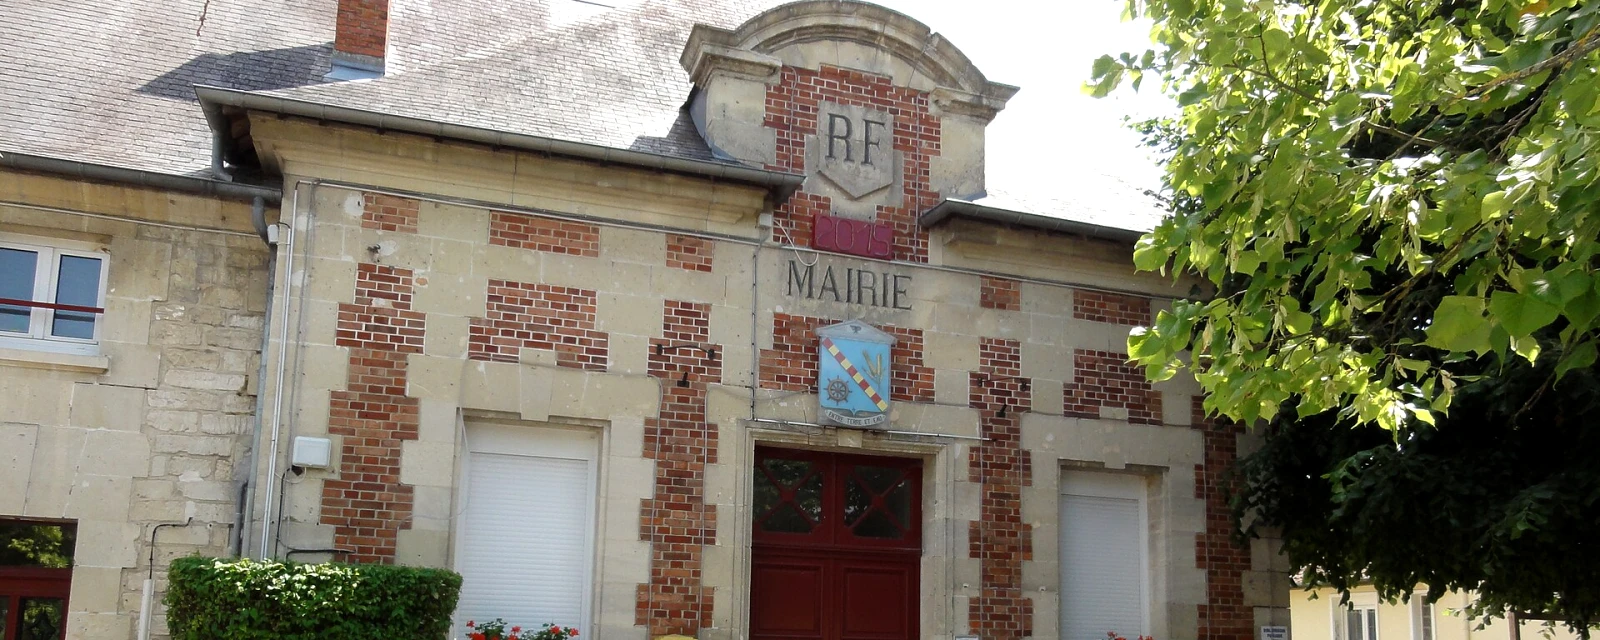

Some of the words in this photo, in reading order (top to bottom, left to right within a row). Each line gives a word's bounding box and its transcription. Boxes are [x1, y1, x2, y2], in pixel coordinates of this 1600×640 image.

[826, 112, 886, 166] RF
[815, 215, 890, 257] 2015
[786, 260, 913, 311] MAIRIE
[828, 411, 844, 423] ENTRE
[847, 418, 862, 426] TERRE
